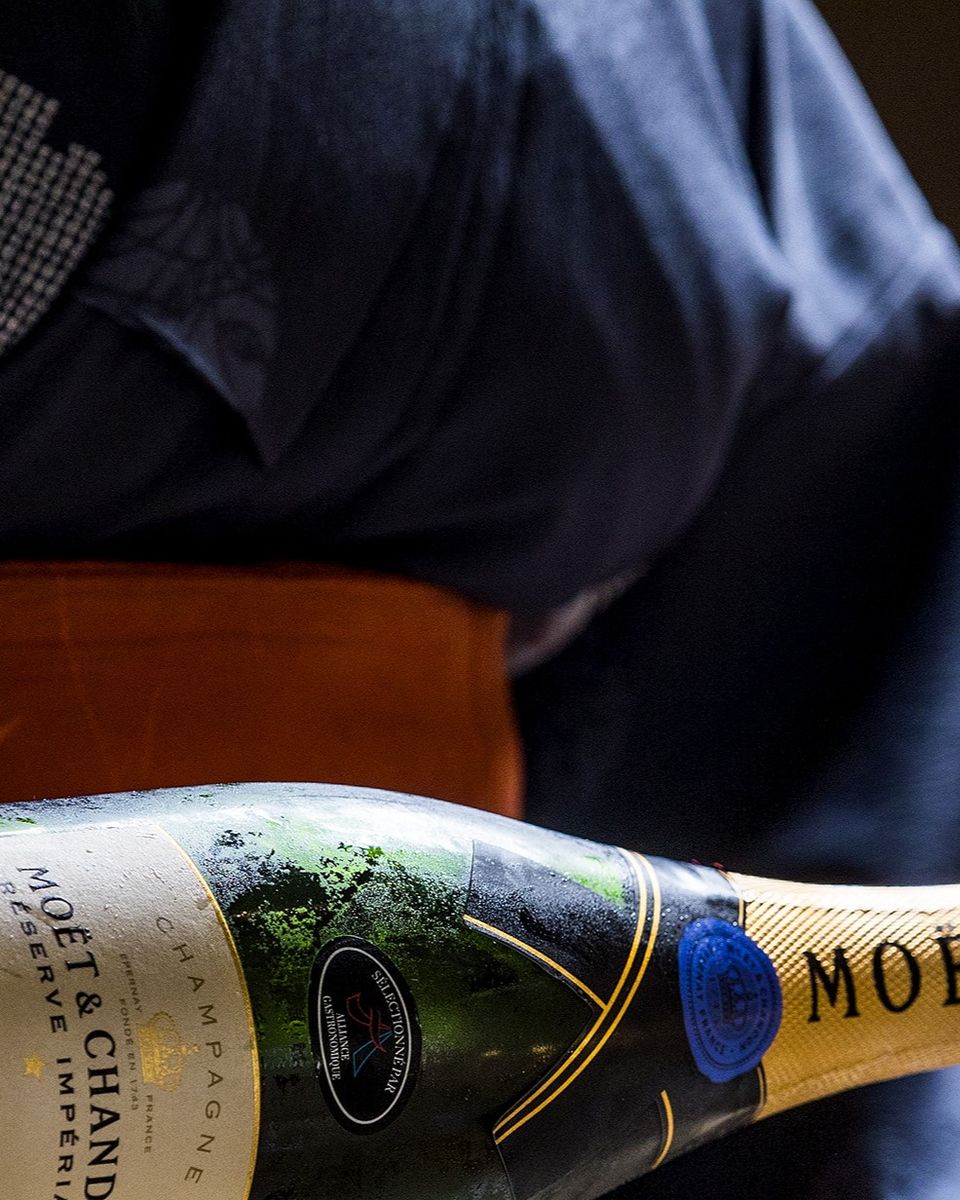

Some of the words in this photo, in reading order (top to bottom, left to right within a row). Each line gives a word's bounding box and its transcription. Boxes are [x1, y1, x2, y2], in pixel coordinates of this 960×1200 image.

[0, 881, 69, 1033] RÉSERVE
[16, 866, 100, 978] MOËT
[75, 991, 102, 1019] &
[156, 916, 224, 1184] CHAMPAGNE
[322, 995, 342, 1081] GASTRONOMIQUE
[335, 1012, 351, 1061] ALLIANCE
[143, 1094, 154, 1155] FRANCE
[383, 1068, 403, 1095] PAR
